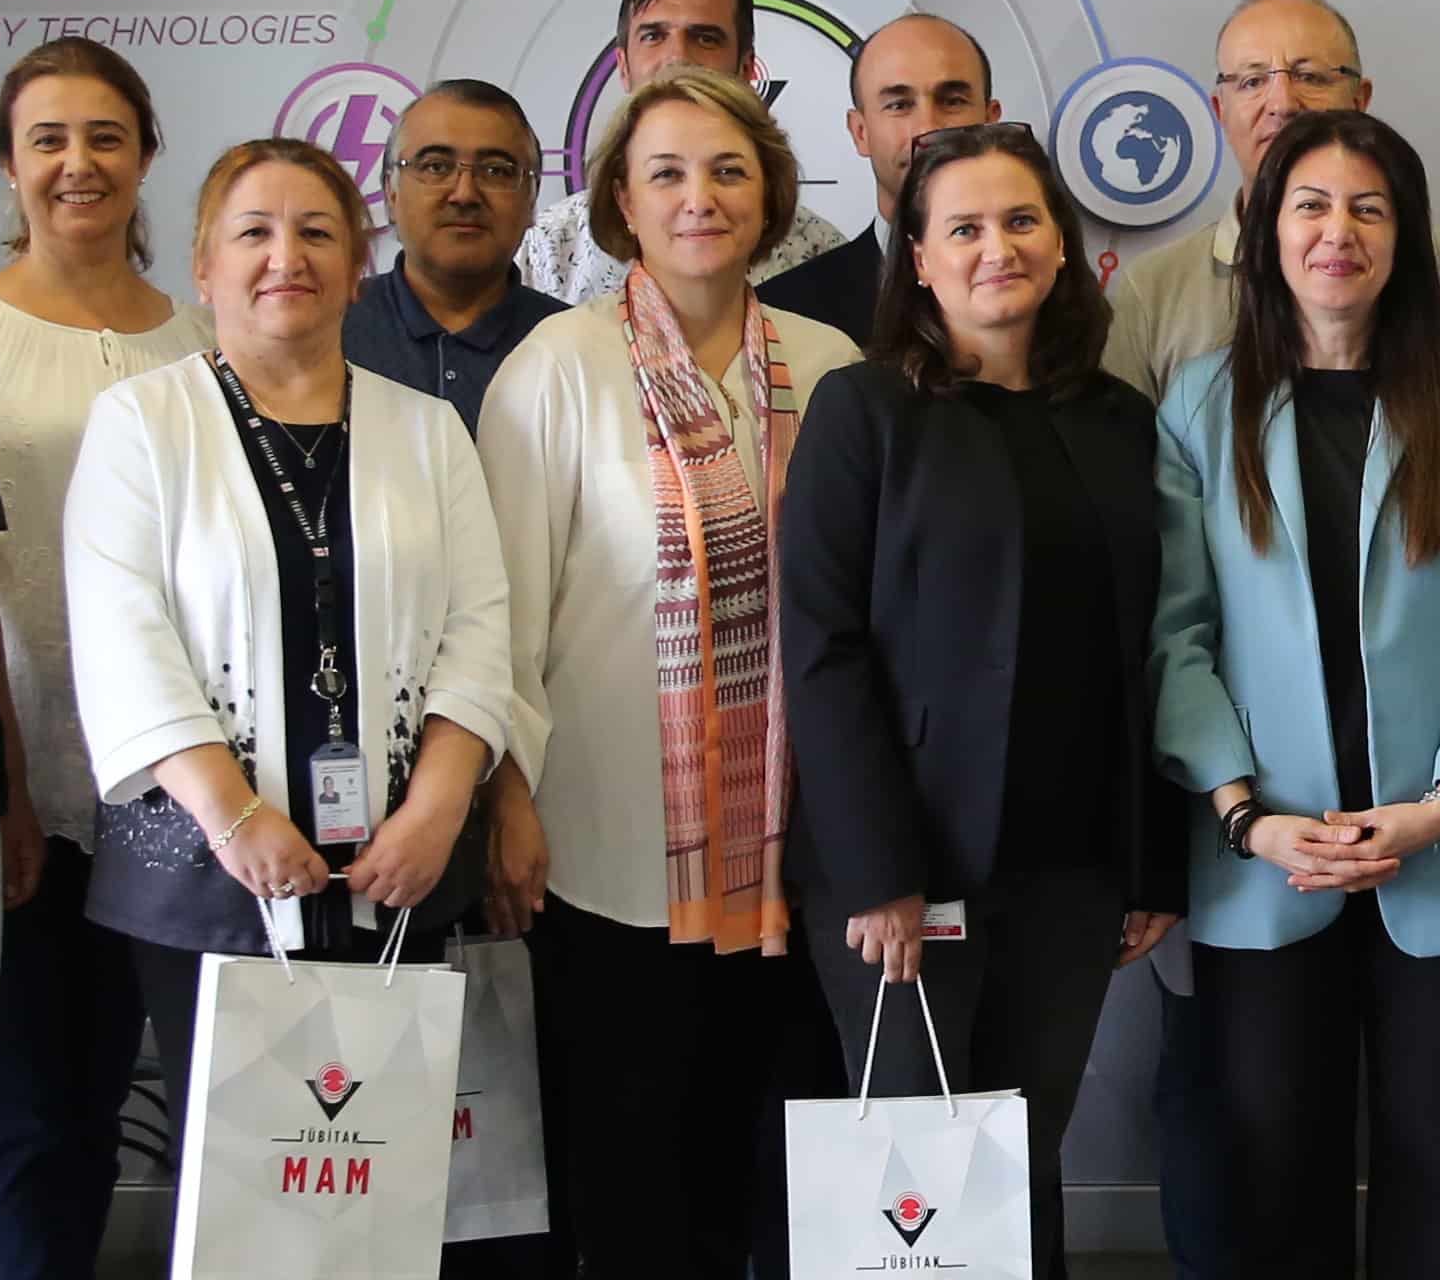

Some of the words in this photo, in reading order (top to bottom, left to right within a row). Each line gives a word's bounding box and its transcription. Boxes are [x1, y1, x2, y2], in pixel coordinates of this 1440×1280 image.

[41, 14, 338, 48] TECHNOLOGIES
[299, 1128, 361, 1144] TÜBİTAK
[281, 1157, 371, 1195] MAM
[882, 1255, 941, 1270] TÜBİTAK
